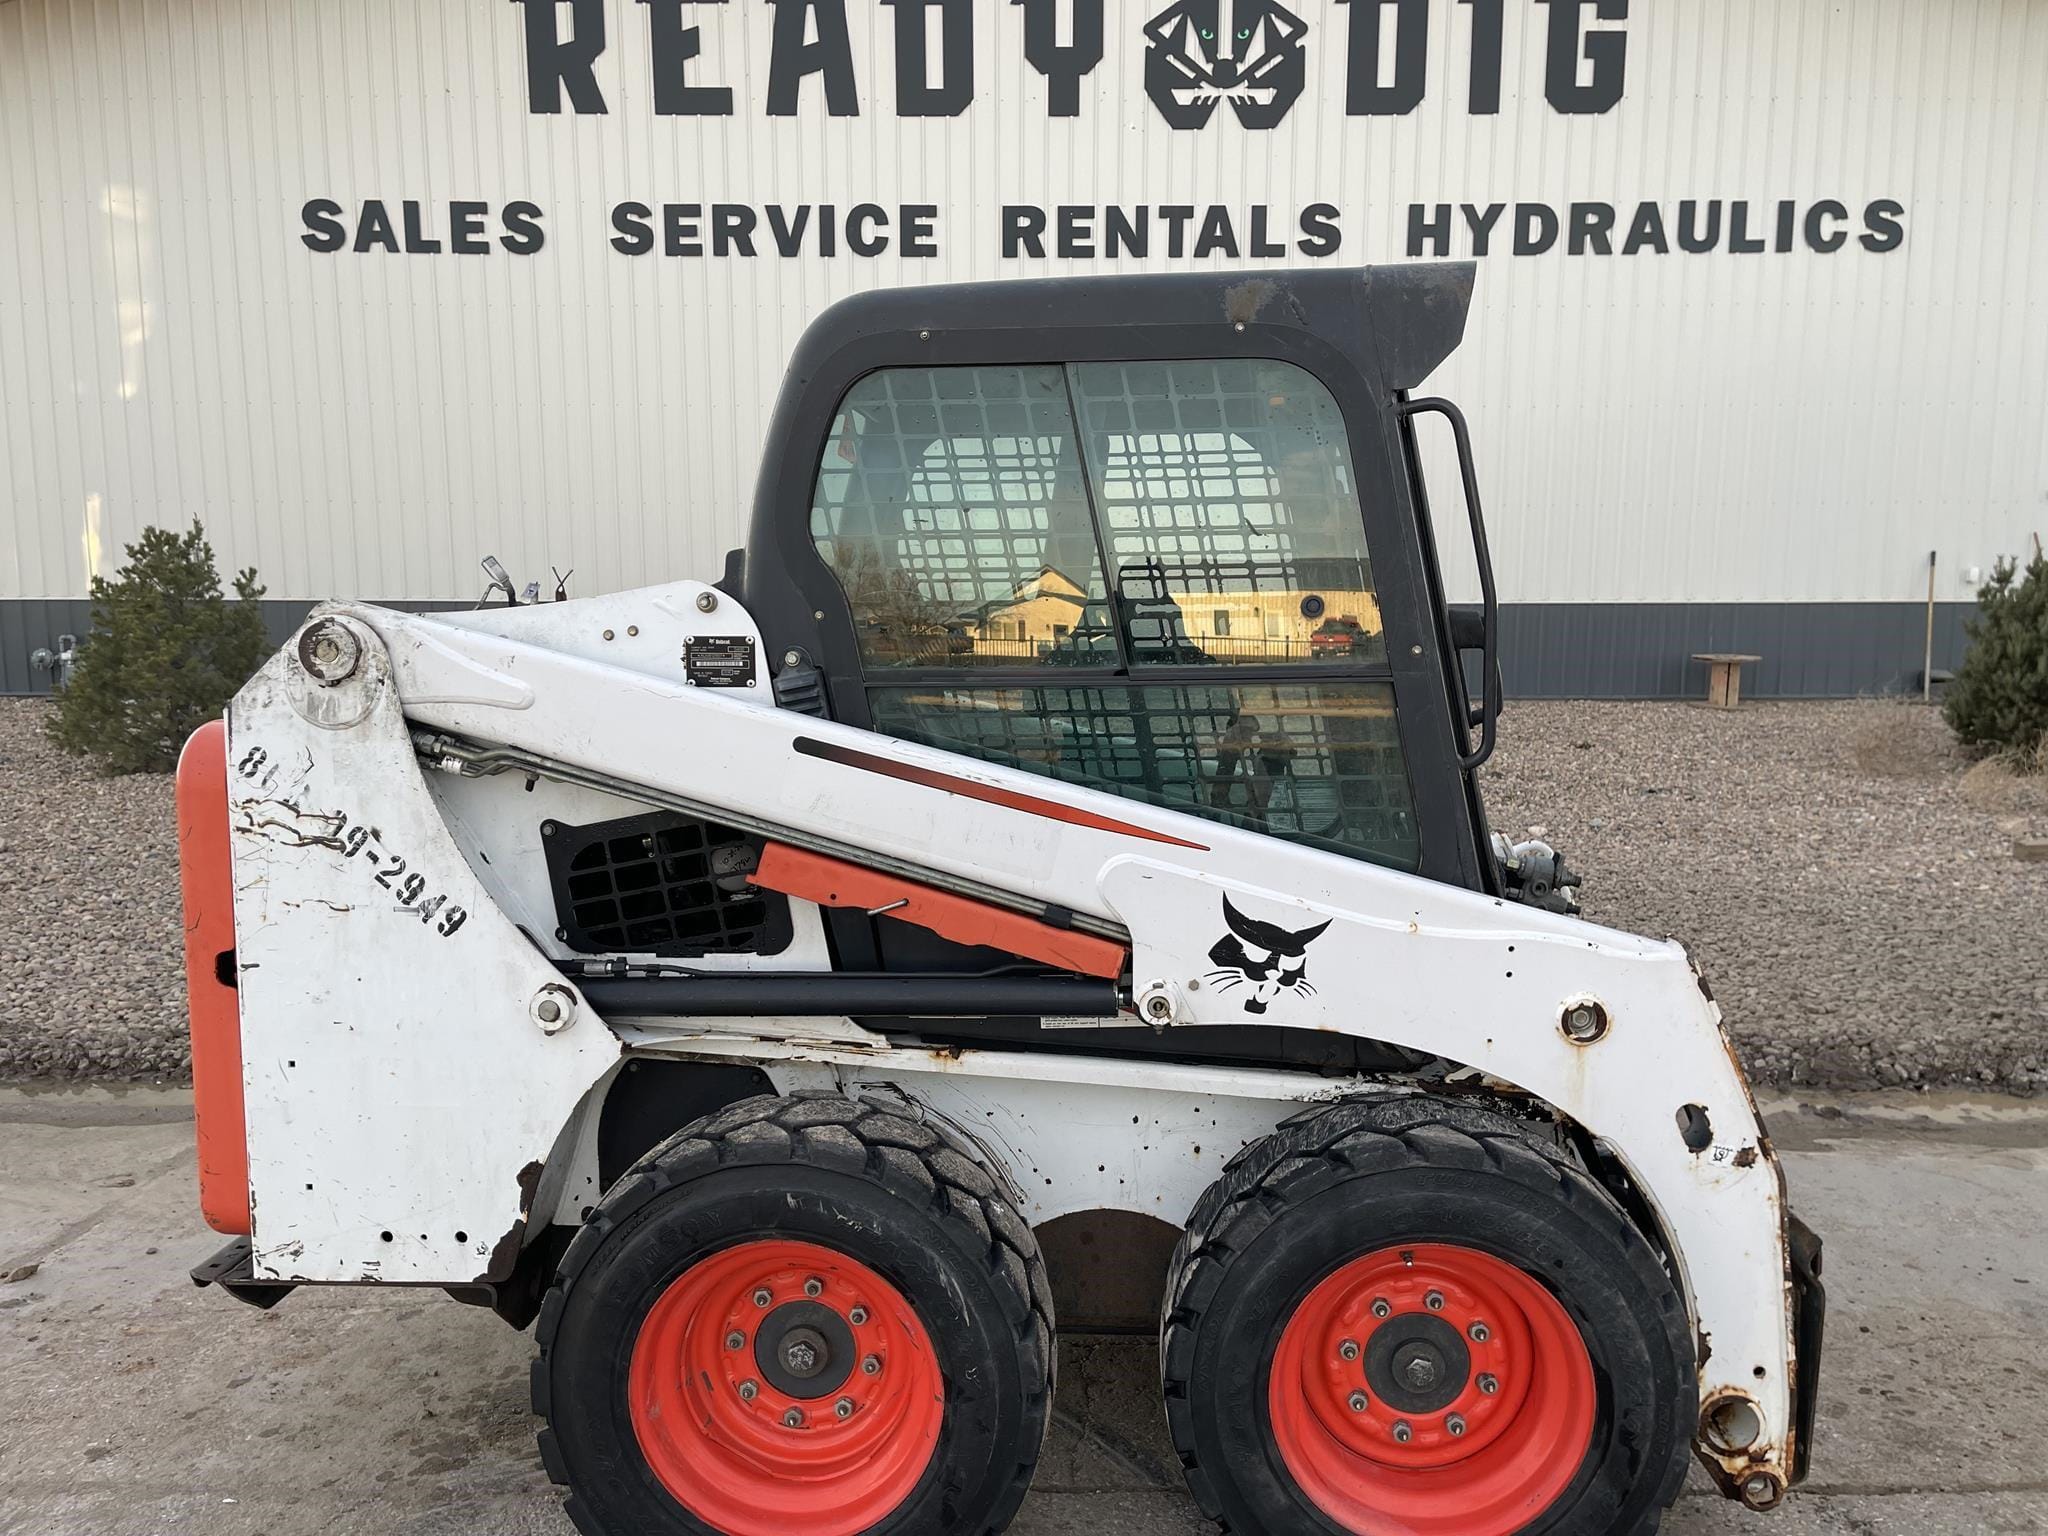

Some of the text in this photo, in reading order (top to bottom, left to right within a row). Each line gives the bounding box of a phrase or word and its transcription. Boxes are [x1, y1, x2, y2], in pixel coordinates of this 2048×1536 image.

[510, 0, 1629, 116] READY DIG
[301, 199, 1905, 258] SALES SERVICE RENTALS HYDRAULICS
